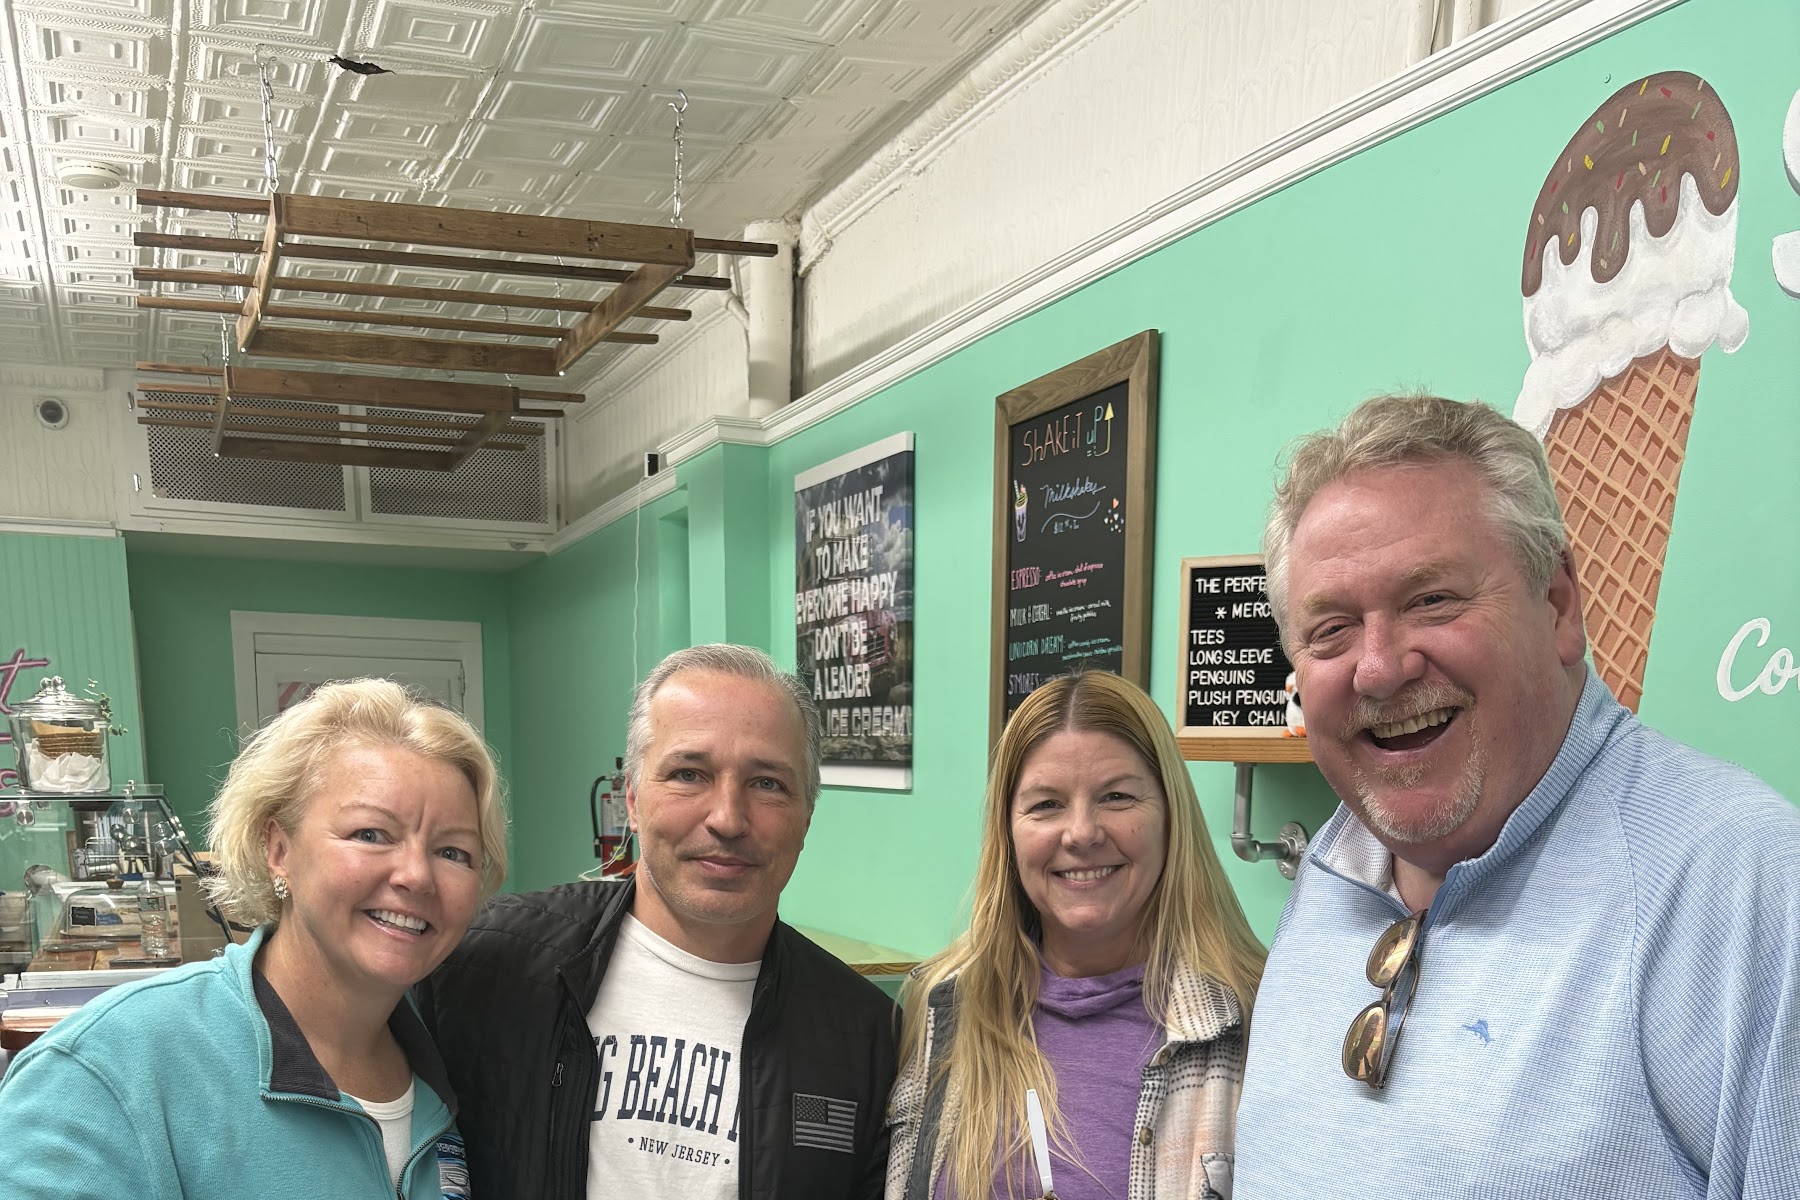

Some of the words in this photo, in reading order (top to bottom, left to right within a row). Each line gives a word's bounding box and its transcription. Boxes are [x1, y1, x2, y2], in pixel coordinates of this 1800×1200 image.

[806, 509, 816, 543] IF
[818, 499, 841, 539] YOU
[844, 485, 883, 530] WANT
[816, 544, 831, 583] TO
[833, 534, 868, 576] MAKE
[796, 582, 848, 625] EVERYONE
[851, 571, 898, 613] HAPPY
[1195, 578, 1221, 594] THE
[851, 620, 868, 656] BE
[1190, 629, 1225, 645] TEES
[1716, 617, 1800, 702] Co
[814, 668, 823, 701] A
[825, 663, 871, 699] LEADER
[1190, 669, 1255, 686] PENGUINS
[1188, 689, 1231, 706] PLUSH
[827, 708, 849, 737] ICE
[851, 705, 912, 737] CREAM
[1212, 710, 1240, 726] KEY
[616, 1034, 732, 1136] BEACH
[639, 1136, 669, 1156] NEW
[671, 1144, 721, 1167] JERSEY
